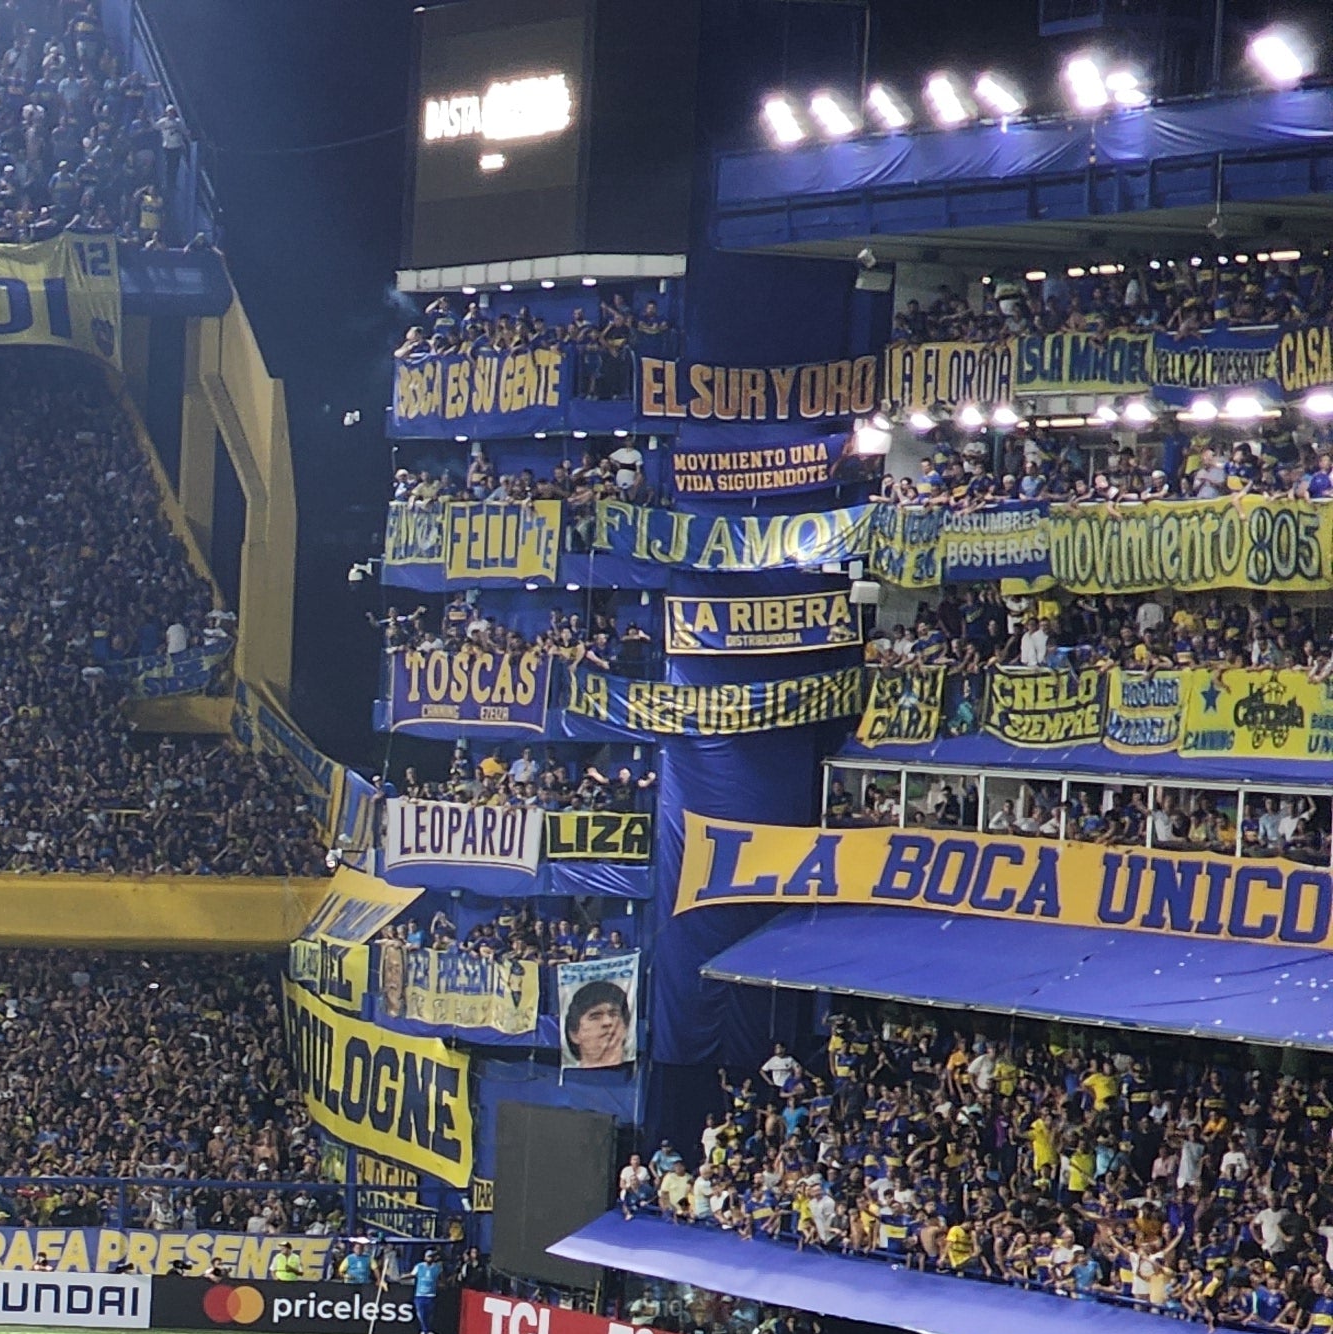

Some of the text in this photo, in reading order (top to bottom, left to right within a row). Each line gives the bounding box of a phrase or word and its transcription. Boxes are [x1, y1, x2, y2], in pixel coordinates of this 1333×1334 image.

[74, 241, 111, 276] 12
[1017, 335, 1063, 384] ISLA
[397, 349, 561, 420] BOCA ES SU GENTE
[641, 355, 878, 421] EL SUR Y ORO
[673, 442, 829, 472] MOVIMIENTO UNA
[675, 463, 829, 493] VIDA SIGUIENDOTE
[942, 508, 1041, 534] COSTUMBRES
[946, 531, 1047, 567] BOSTERAS
[1050, 505, 1320, 588] movimiento 805
[673, 594, 852, 633] LA RIBERA
[405, 651, 539, 706] TOSCAS
[992, 669, 1097, 710] CHELO
[627, 667, 861, 736] REPUBLICANA
[1004, 704, 1100, 741] SIEMPRE
[399, 806, 528, 859] LEOPARDI
[549, 815, 650, 854] LIZA
[696, 826, 1333, 944] LA BOCA UNICO
[92, 1231, 332, 1282] PRESENTE
[273, 1292, 415, 1325] priceless
